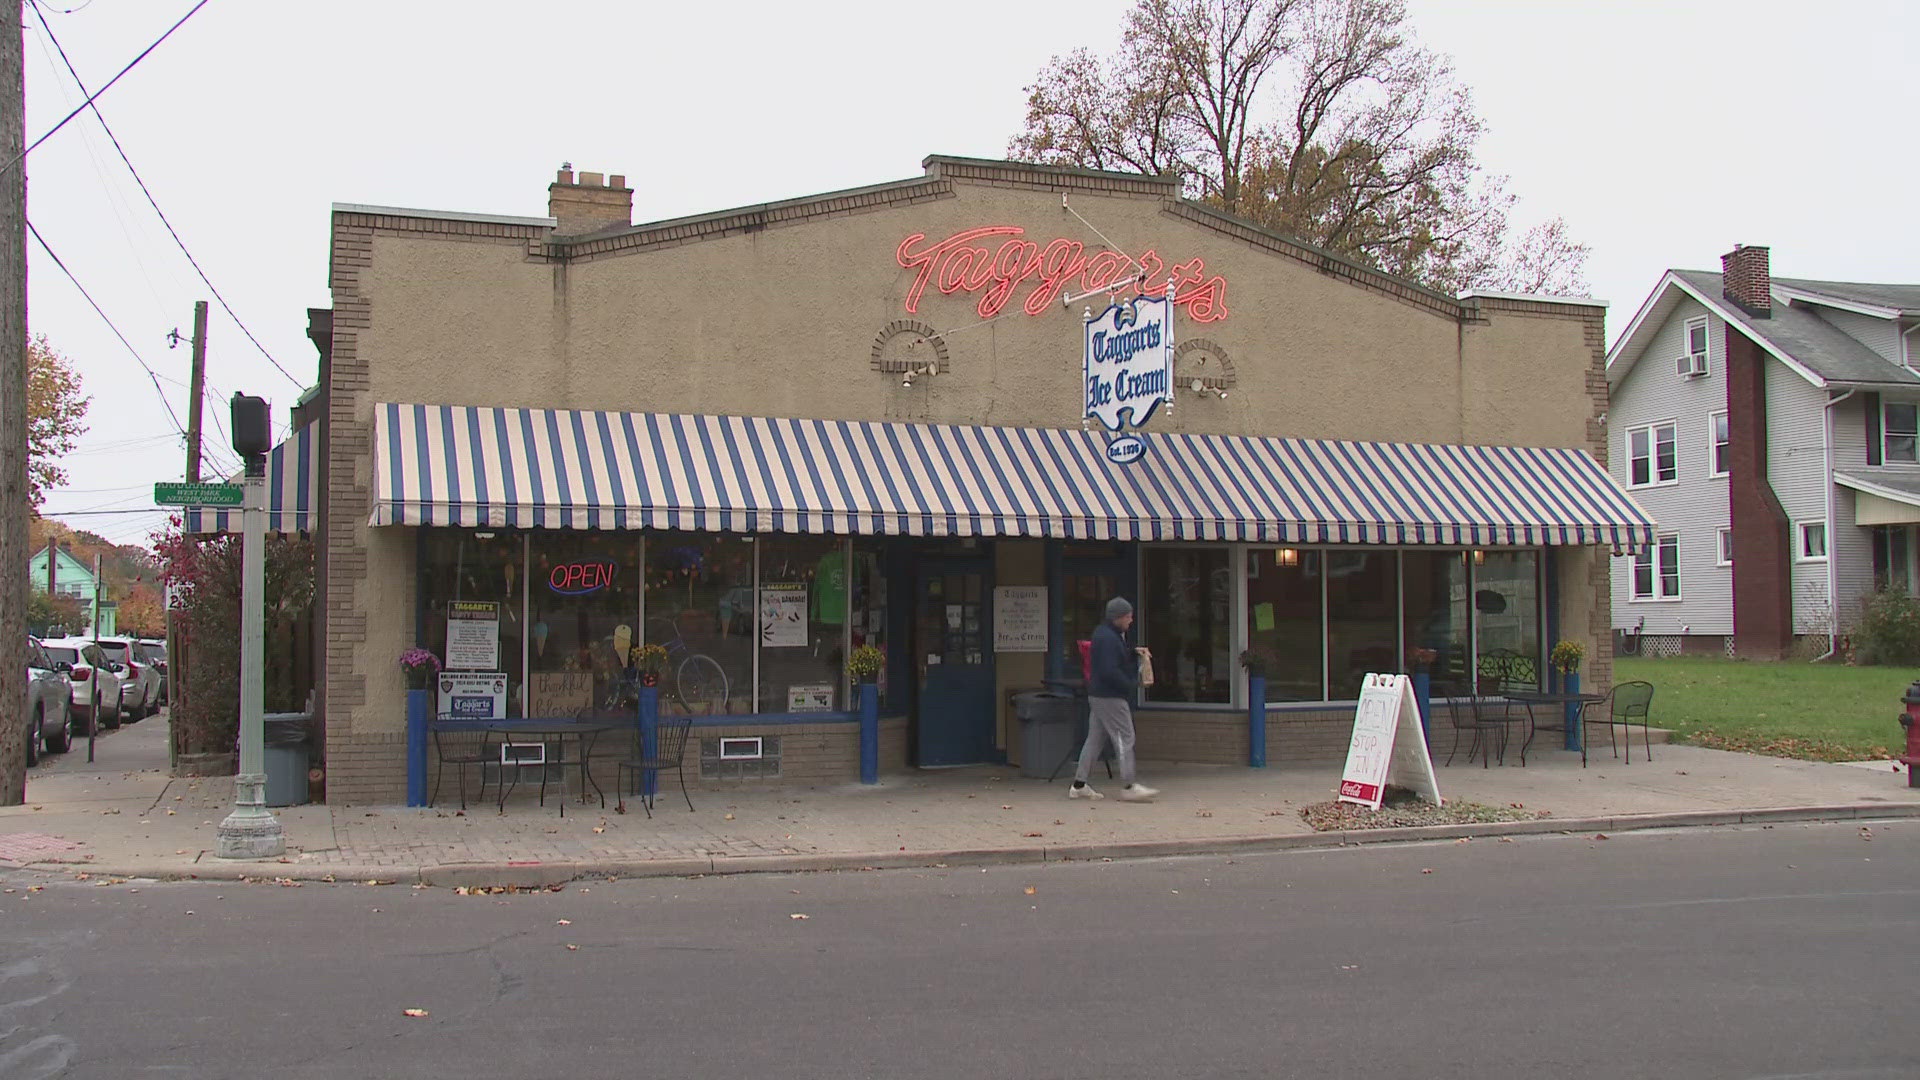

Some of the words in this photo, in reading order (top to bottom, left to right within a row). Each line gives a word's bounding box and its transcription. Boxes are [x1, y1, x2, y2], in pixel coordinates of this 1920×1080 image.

[896, 226, 1228, 323] Taggarts
[1092, 318, 1162, 364] Taggarts
[1089, 379, 1112, 409] Ice
[1115, 368, 1165, 402] Cream
[165, 494, 234, 503] NEIGHBORHOOD
[549, 562, 614, 589] OPEN
[454, 603, 494, 611] TAGGART'S
[1352, 733, 1378, 752] STOP
